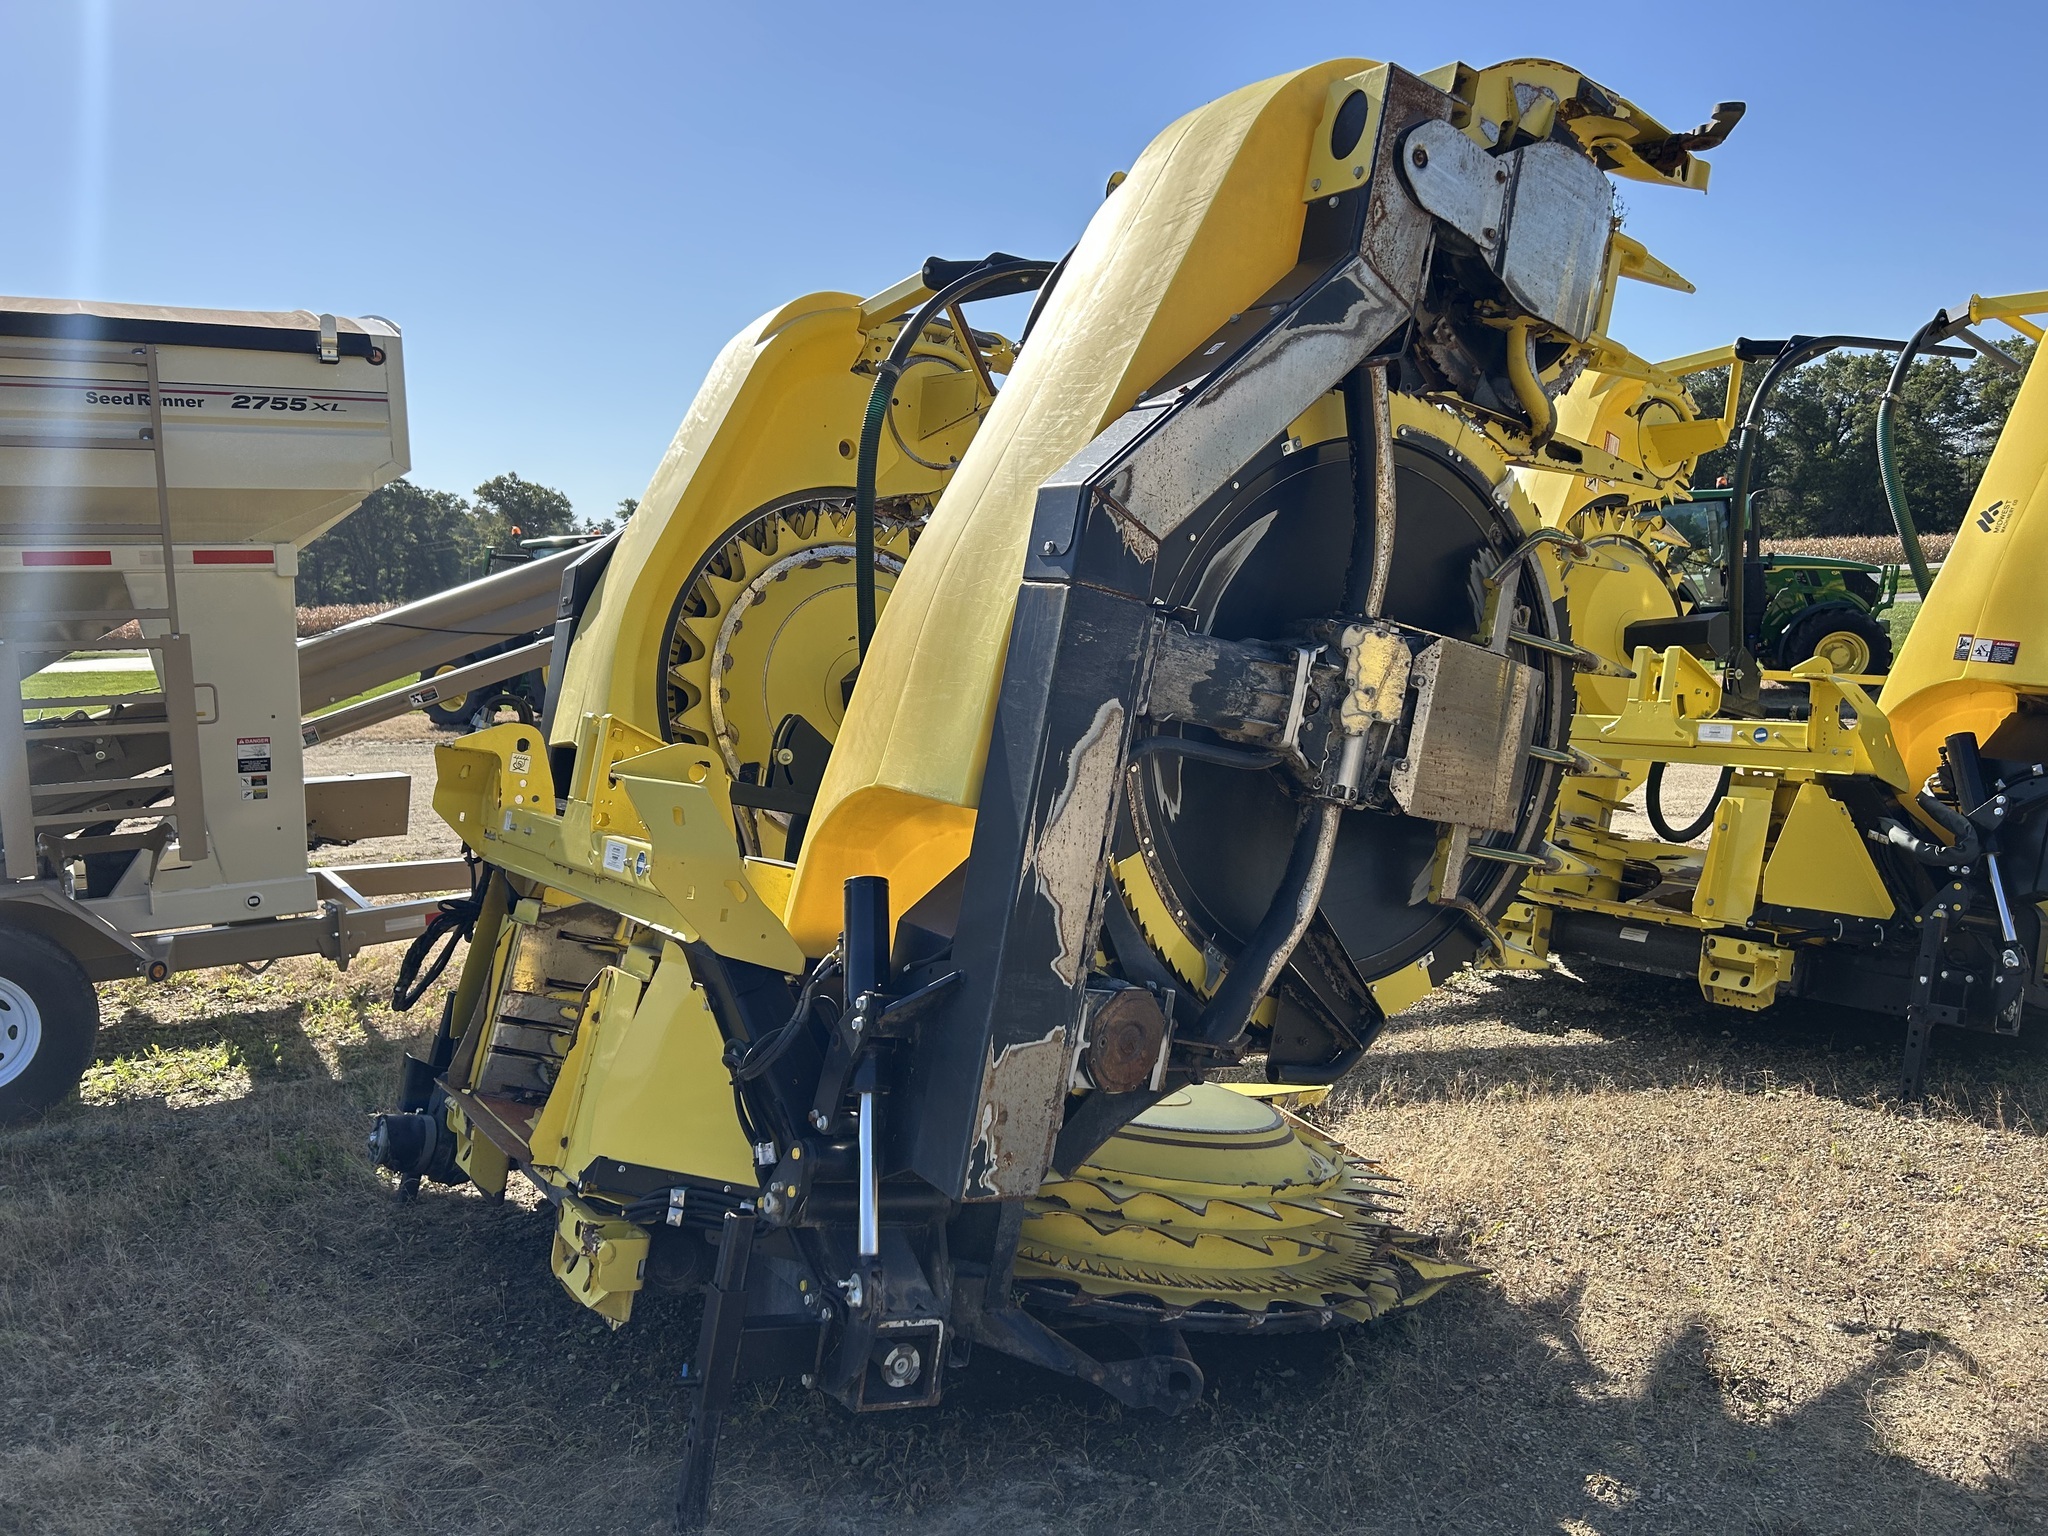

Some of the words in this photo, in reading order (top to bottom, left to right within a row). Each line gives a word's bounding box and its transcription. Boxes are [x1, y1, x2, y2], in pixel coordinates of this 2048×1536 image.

[85, 391, 134, 406] Seed
[137, 393, 205, 408] Rnner
[1993, 500, 2012, 533] MIDWEST
